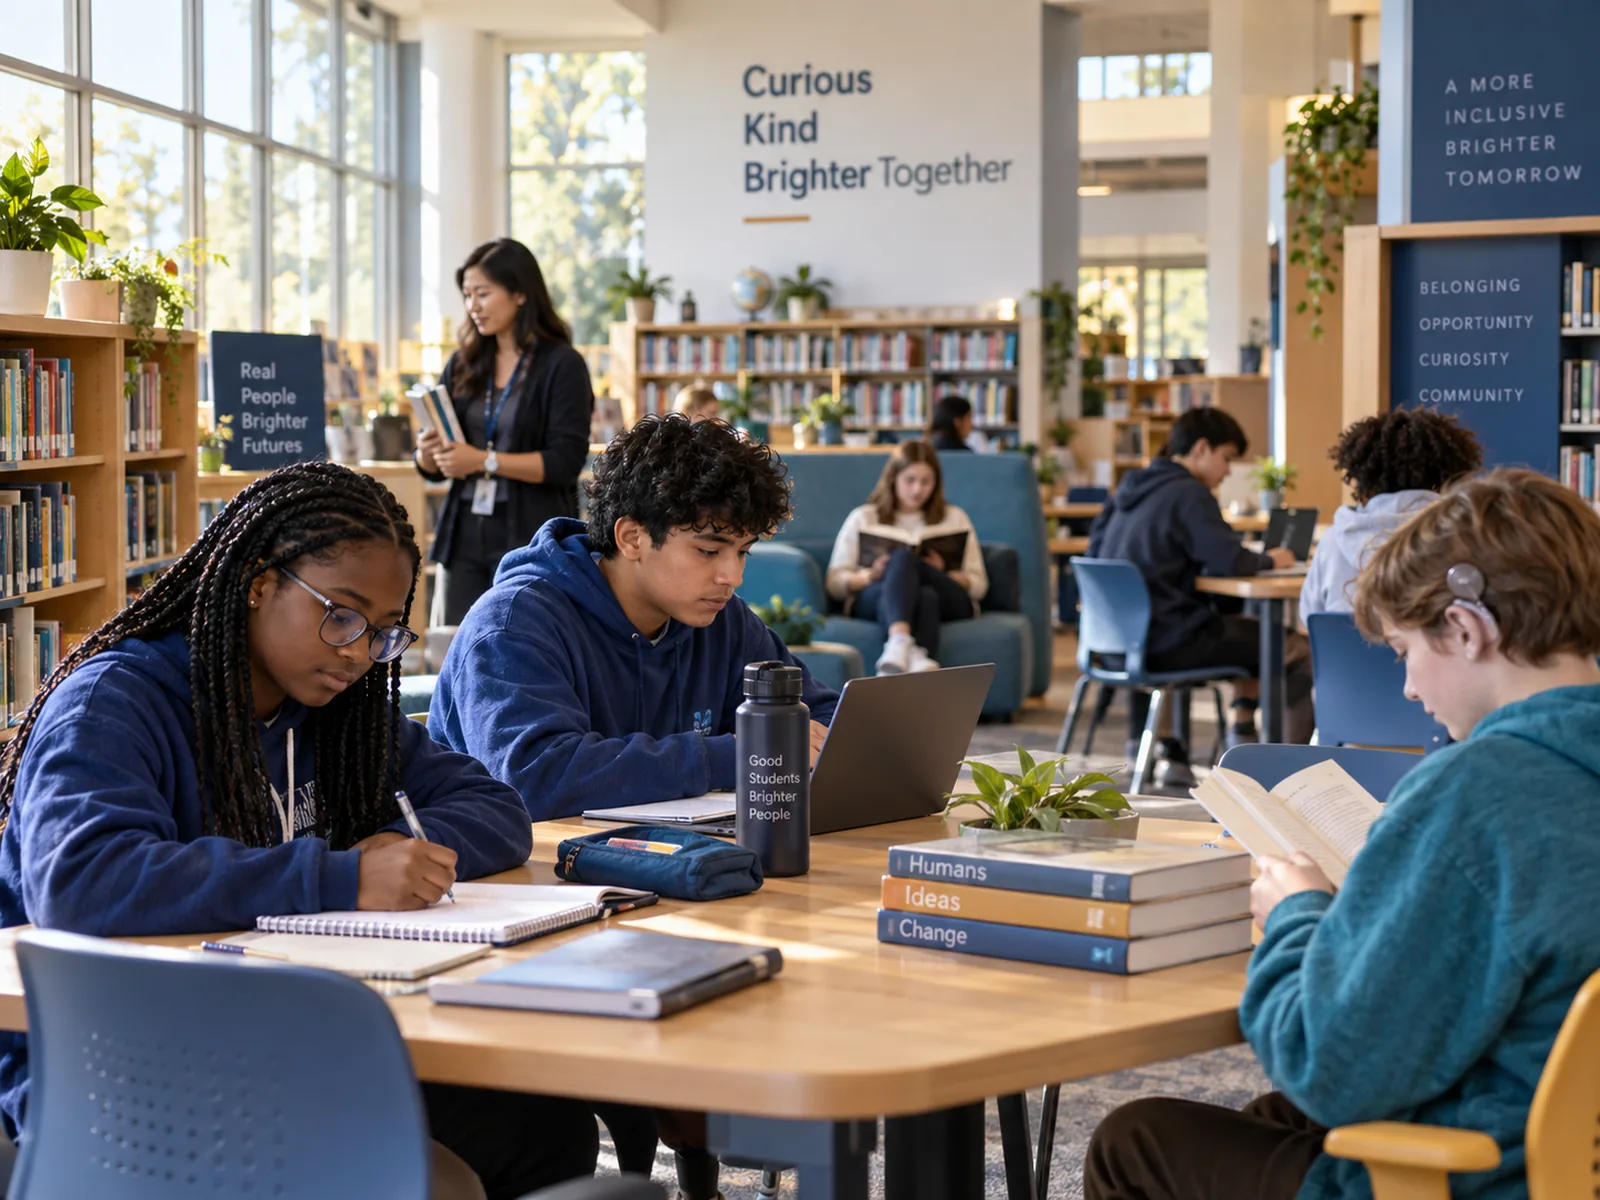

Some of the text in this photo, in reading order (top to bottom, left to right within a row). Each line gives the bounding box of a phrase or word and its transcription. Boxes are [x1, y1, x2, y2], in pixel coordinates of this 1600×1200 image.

[743, 63, 873, 98] Curious
[1445, 73, 1534, 95] A MORE
[1445, 102, 1565, 126] INCLUSIVE
[744, 110, 818, 145] Kind
[1445, 134, 1556, 156] BRIGHTER
[744, 151, 1012, 200] Brighter Together
[1445, 164, 1582, 187] TOMORROW
[1420, 278, 1521, 295] BELONGING
[1419, 315, 1534, 331] OPPORTUNITY
[240, 361, 276, 379] Real
[1419, 352, 1510, 367] CURIOSITY
[241, 387, 297, 408] People
[1419, 388, 1524, 403] COMMUNITY
[241, 412, 308, 435] Brighter
[242, 437, 303, 455] Futures
[749, 754, 783, 767] Good
[749, 772, 800, 784] Students
[749, 790, 797, 806] Brighter
[749, 808, 791, 823] People
[909, 854, 987, 881] Humans
[905, 885, 960, 912] Ideas
[899, 918, 968, 948] Change
